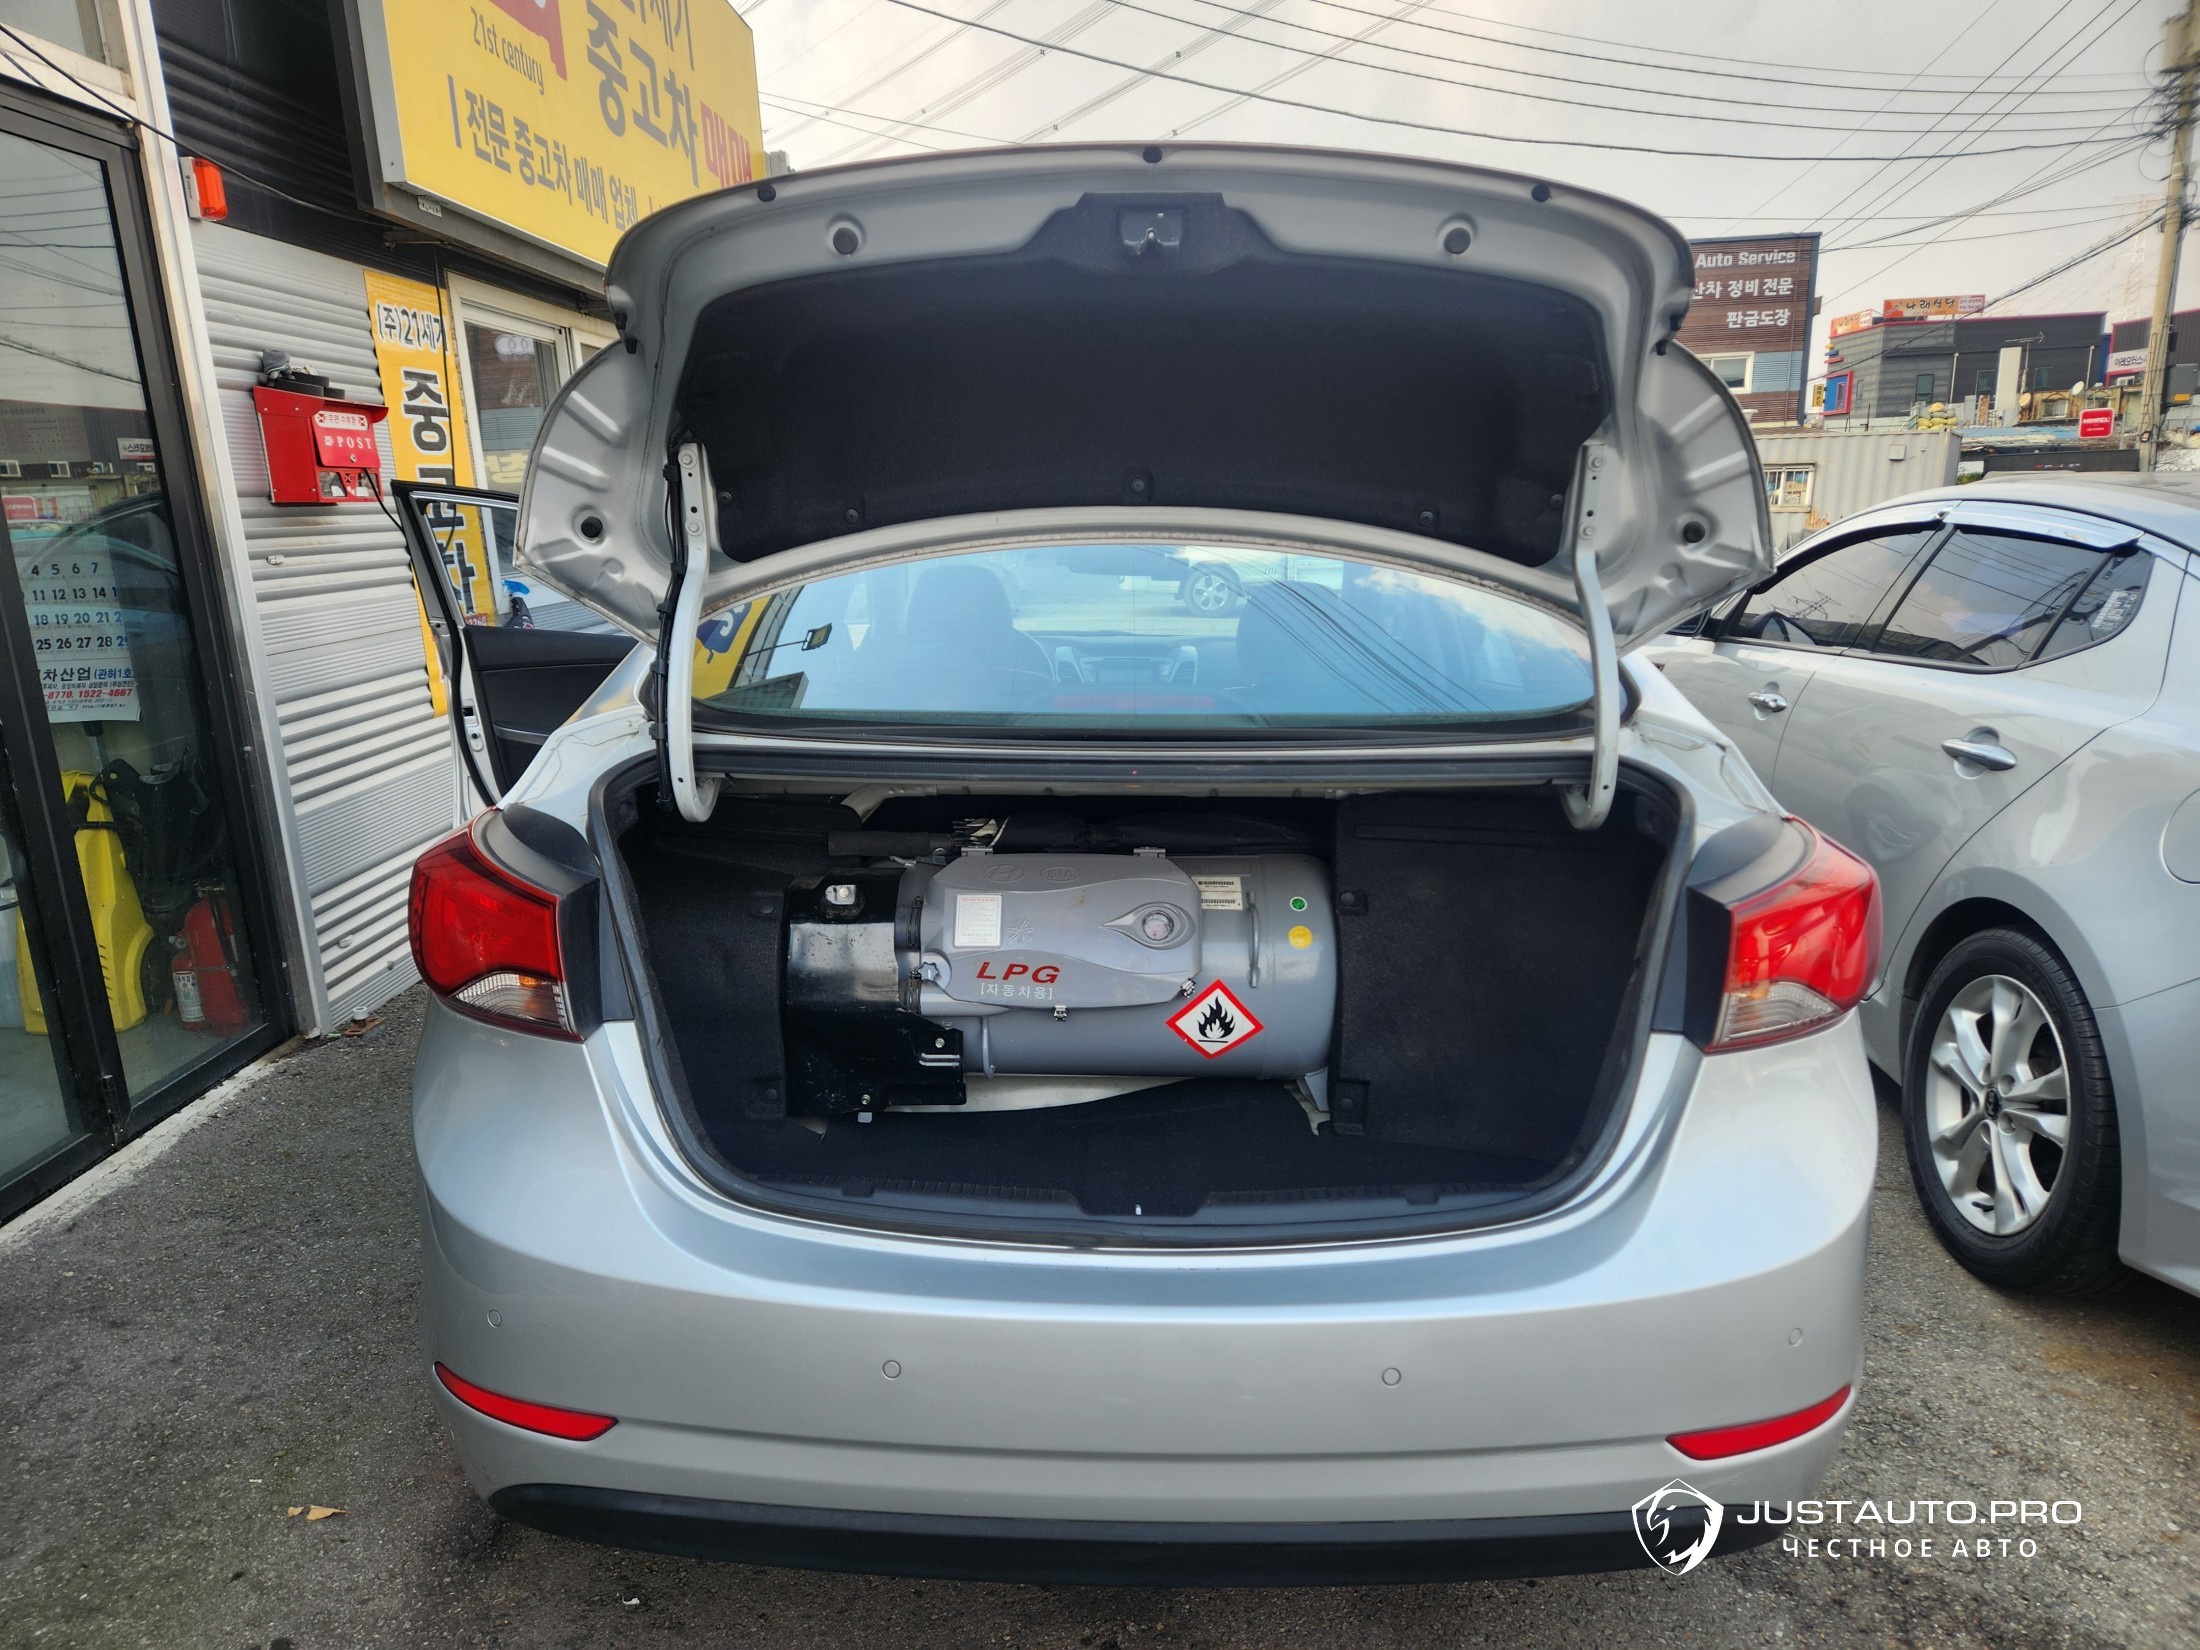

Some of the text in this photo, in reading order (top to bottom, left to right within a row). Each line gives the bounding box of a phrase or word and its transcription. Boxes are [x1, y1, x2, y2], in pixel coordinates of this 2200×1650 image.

[470, 6, 544, 96] 21st century
[587, 2, 700, 188] 중고차
[464, 88, 512, 174] 전문
[513, 115, 572, 206] 중고차
[573, 156, 610, 225] 매매
[1694, 249, 1796, 269] Auto Service
[1728, 279, 1759, 298] 정비
[1762, 277, 1793, 296] 전문
[1726, 308, 1790, 329] 판금도장
[336, 435, 372, 449] POST
[31, 562, 98, 576] 4 5 6 7
[32, 589, 46, 601] 11
[52, 588, 66, 600] 12
[72, 587, 86, 599] 13
[92, 587, 106, 598] 14
[34, 614, 49, 626] 18
[54, 613, 69, 625] 19
[74, 612, 90, 624] 20
[96, 611, 109, 623] 21
[36, 638, 52, 650] 25
[56, 637, 72, 650] 26
[76, 636, 92, 648] 27
[97, 636, 113, 648] 28
[38, 666, 91, 682] 차산업
[78, 688, 133, 698] 1522-4667
[976, 961, 1060, 984] LPG
[981, 982, 1053, 1000] [자동차용]
